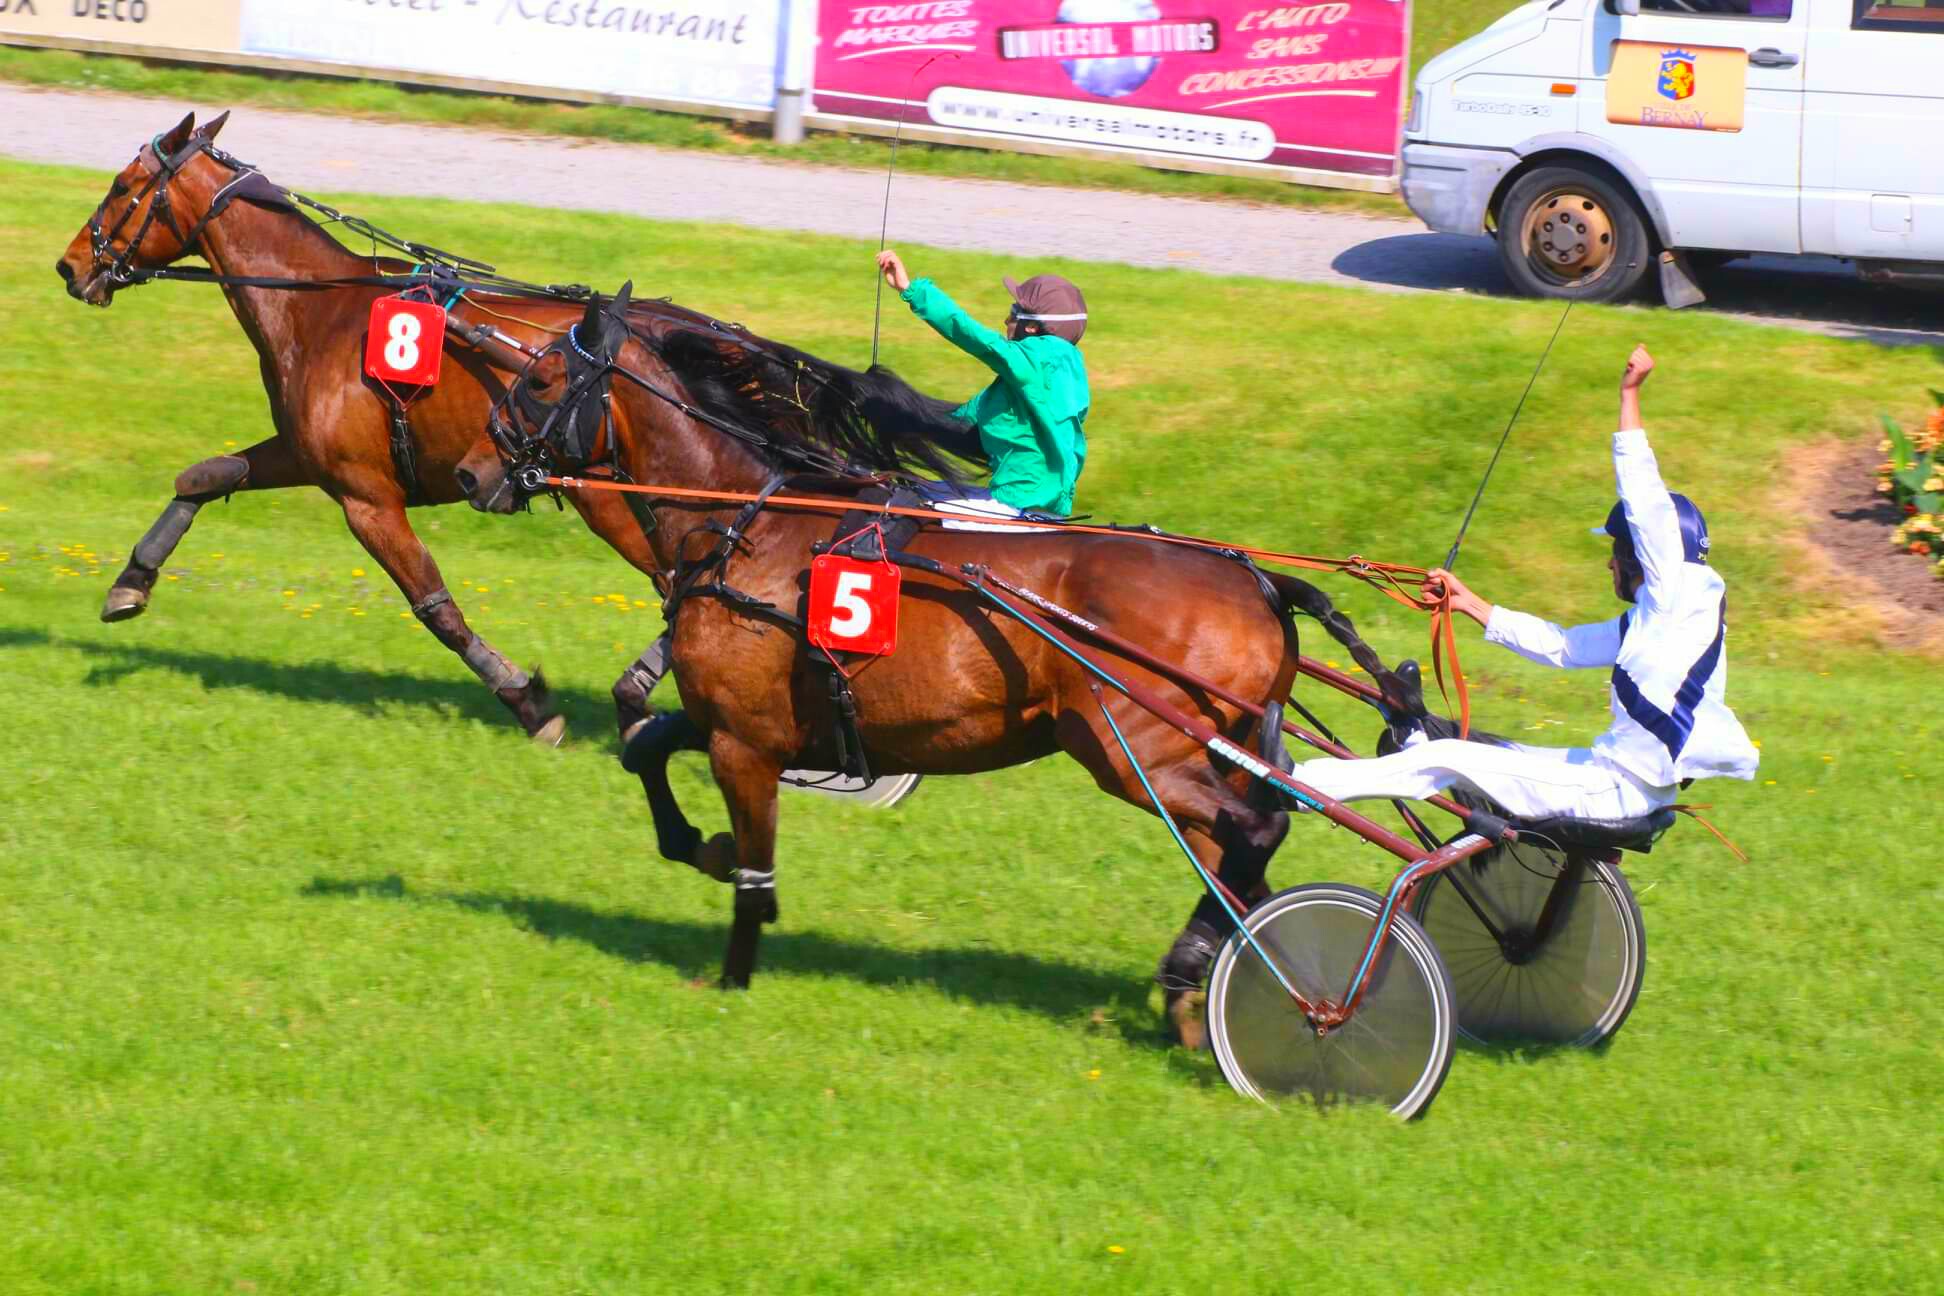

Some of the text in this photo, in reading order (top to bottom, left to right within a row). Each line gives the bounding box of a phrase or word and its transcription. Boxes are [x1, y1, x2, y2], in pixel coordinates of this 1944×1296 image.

[849, 0, 974, 24] TOUTES
[833, 20, 980, 47] MARQUES
[1002, 23, 1214, 58] UNIVERSAL MOTORS
[1246, 34, 1328, 59] SANS
[384, 313, 421, 370] 8
[829, 571, 872, 637] 5
